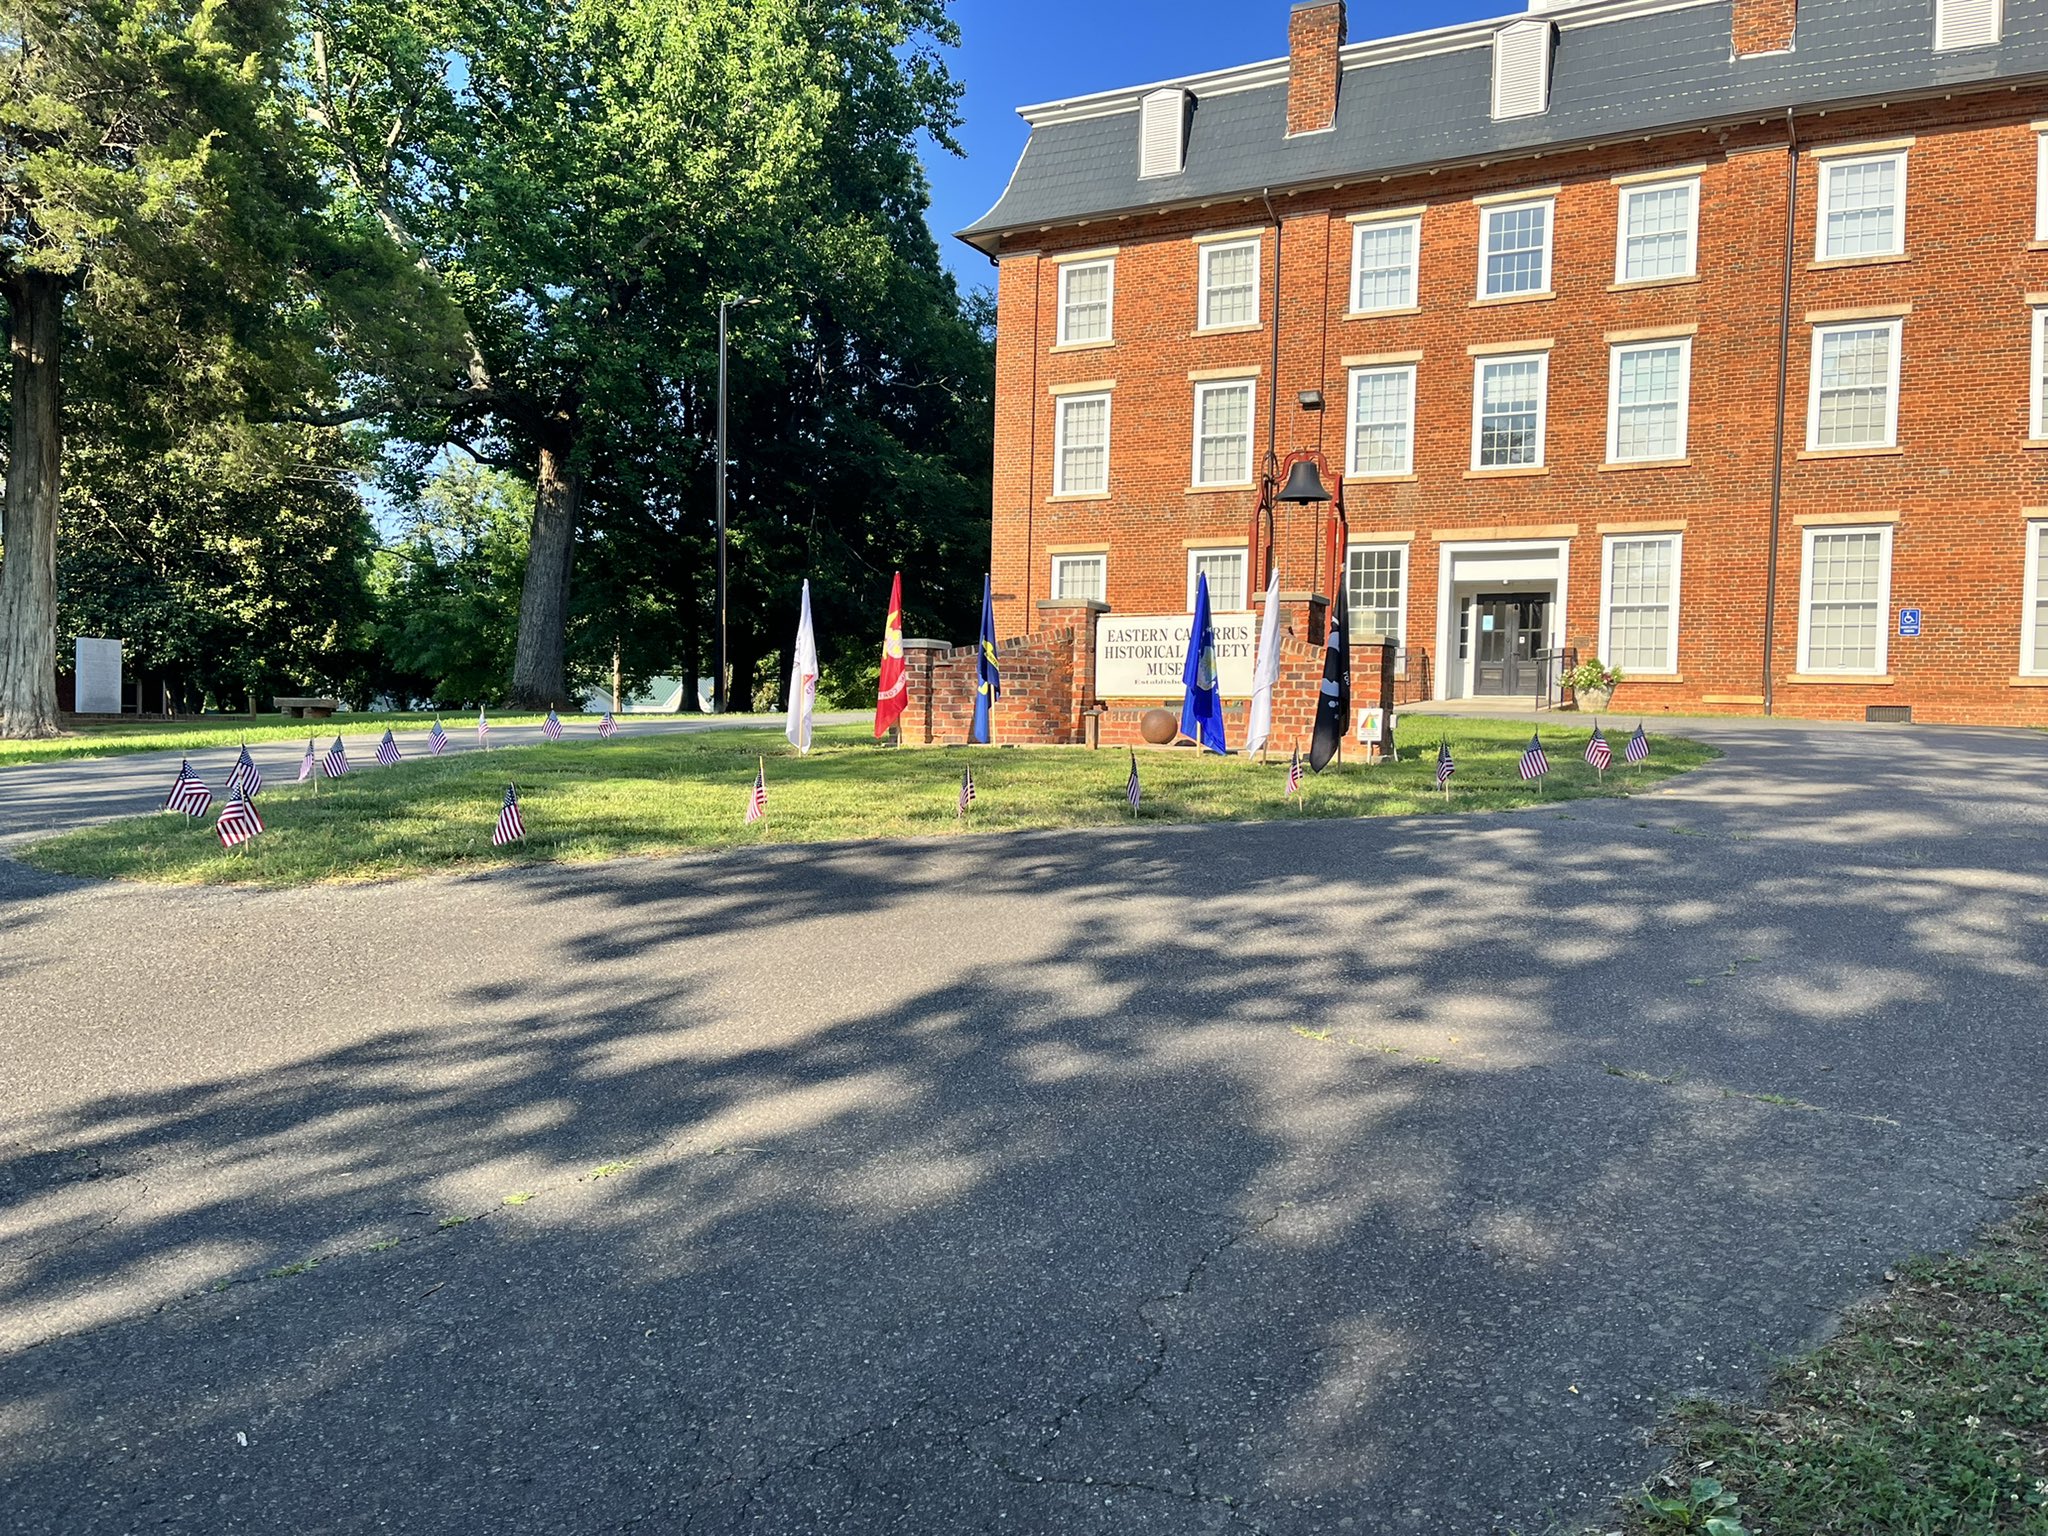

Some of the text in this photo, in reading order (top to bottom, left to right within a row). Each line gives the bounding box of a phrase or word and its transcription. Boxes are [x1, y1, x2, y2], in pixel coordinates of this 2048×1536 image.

[1107, 627, 1248, 643] EASTERN CARRUS
[1105, 645, 1184, 659] HISTORICAL
[1146, 663, 1185, 676] MUSE
